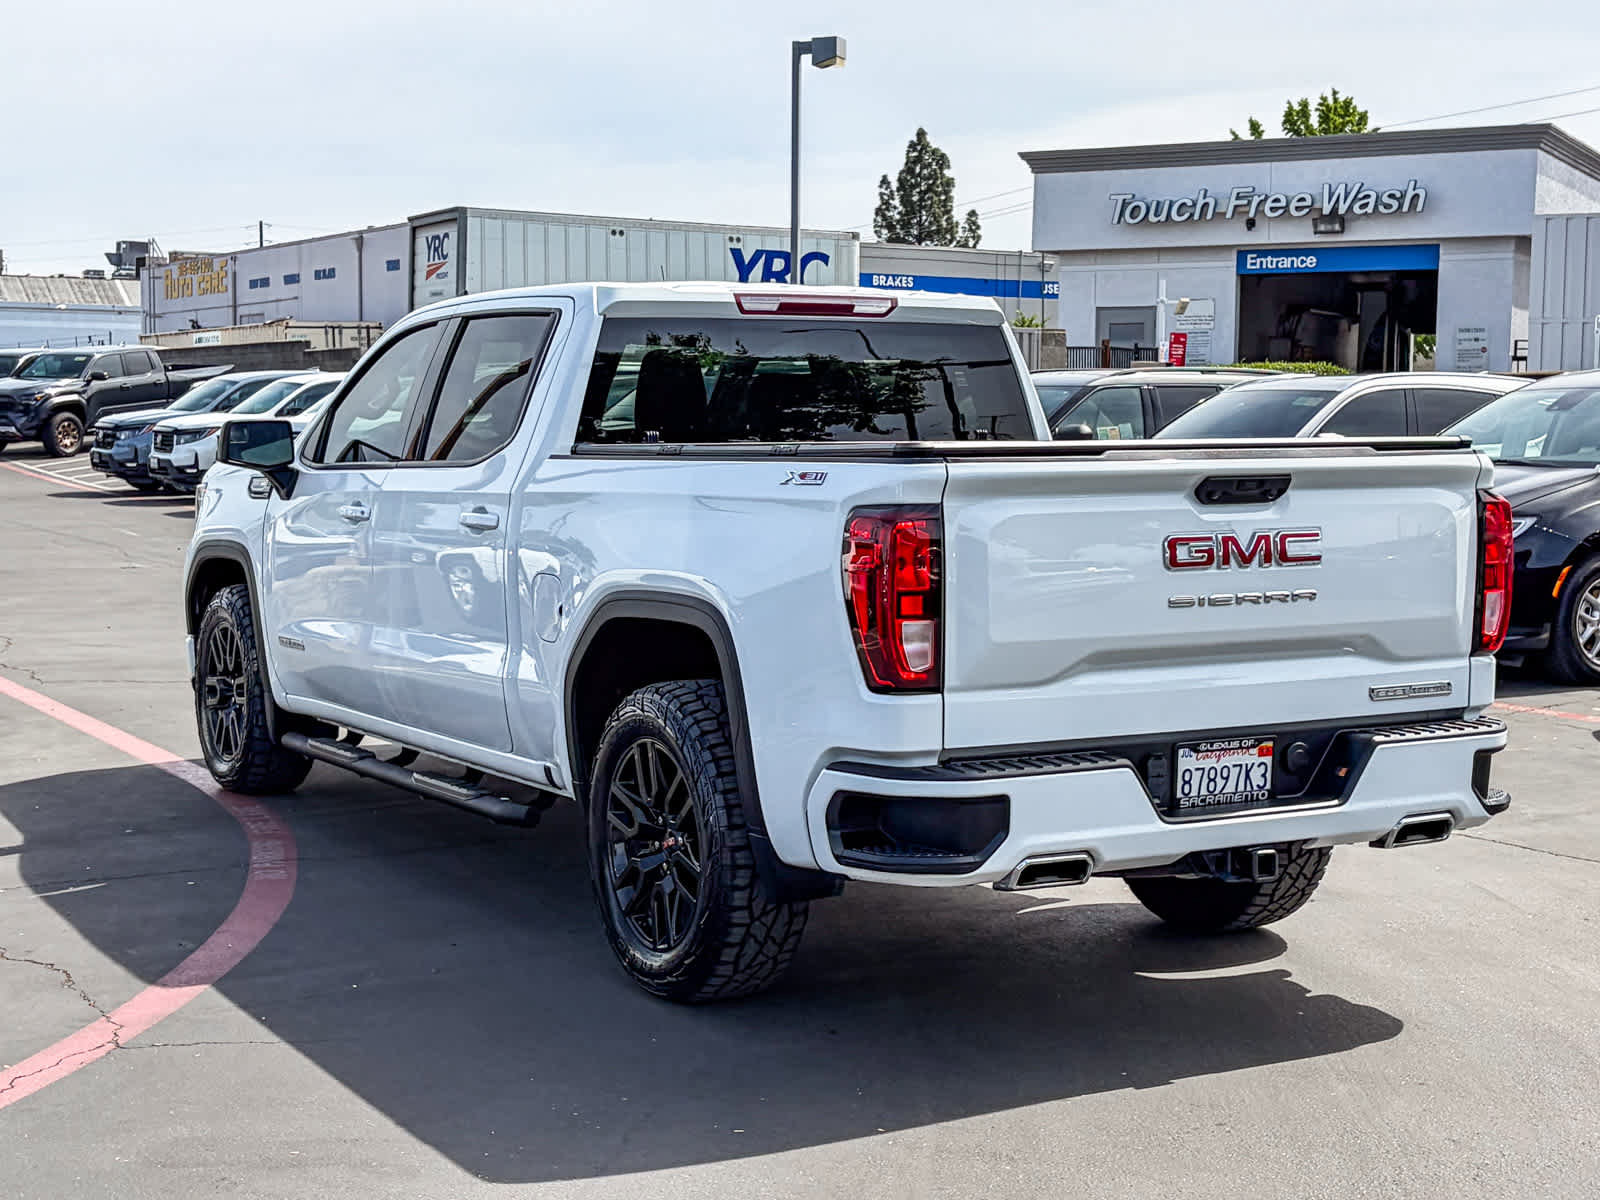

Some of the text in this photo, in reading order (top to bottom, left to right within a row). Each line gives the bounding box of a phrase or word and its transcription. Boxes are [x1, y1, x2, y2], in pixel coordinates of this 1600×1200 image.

[1109, 179, 1428, 226] Touch Free Wash
[425, 232, 450, 262] YRC
[1246, 253, 1317, 270] Entrance
[872, 274, 914, 288] BRAKES
[1163, 527, 1322, 571] GMC
[1167, 588, 1318, 609] SIERRA
[1207, 739, 1255, 750] LEXUS OF
[1181, 761, 1268, 796] 87897K3
[1179, 790, 1269, 808] SACRAMENTO
